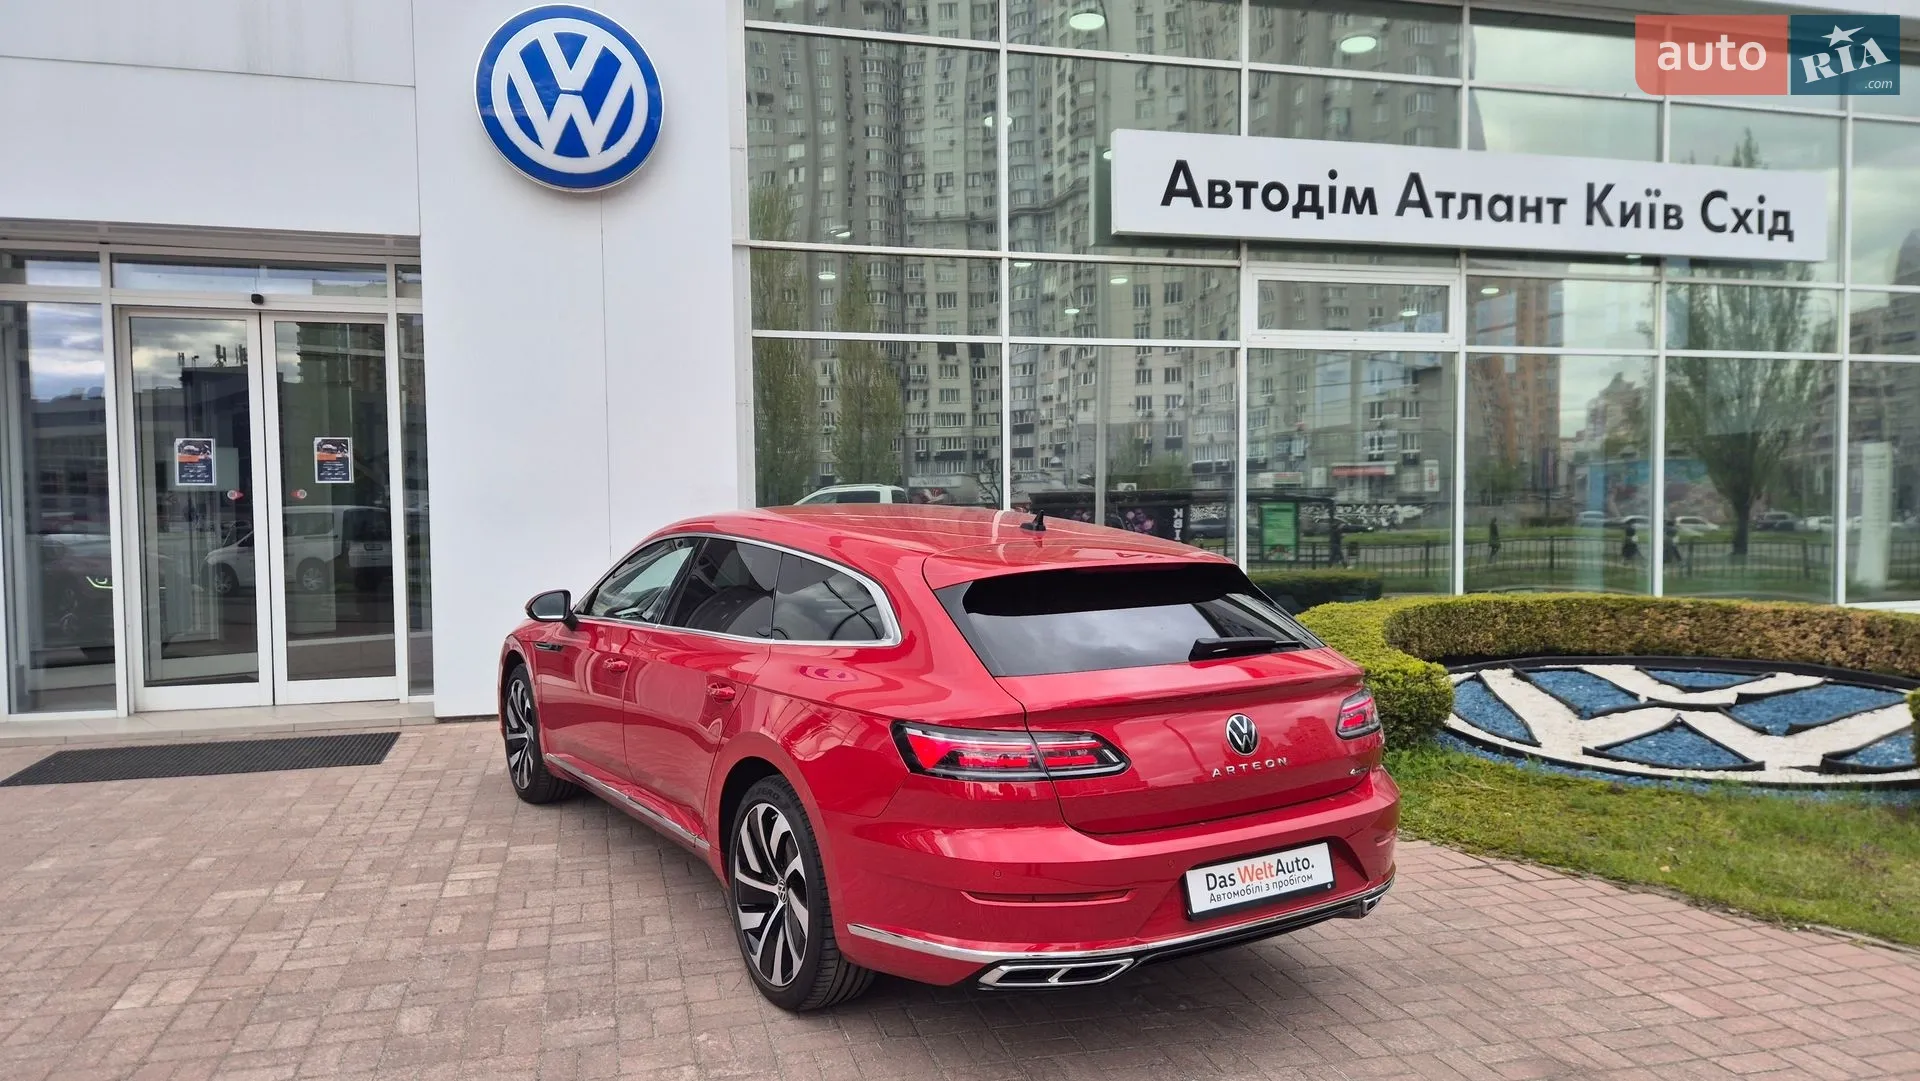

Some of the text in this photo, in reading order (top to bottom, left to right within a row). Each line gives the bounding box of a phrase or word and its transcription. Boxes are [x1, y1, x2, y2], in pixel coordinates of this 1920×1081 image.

[1160, 159, 1795, 242] Автодім Атлант Київ Схід
[1212, 757, 1288, 777] ARTEON
[1205, 872, 1236, 891] Das
[1209, 873, 1314, 904] Автомобілі з пробігом
